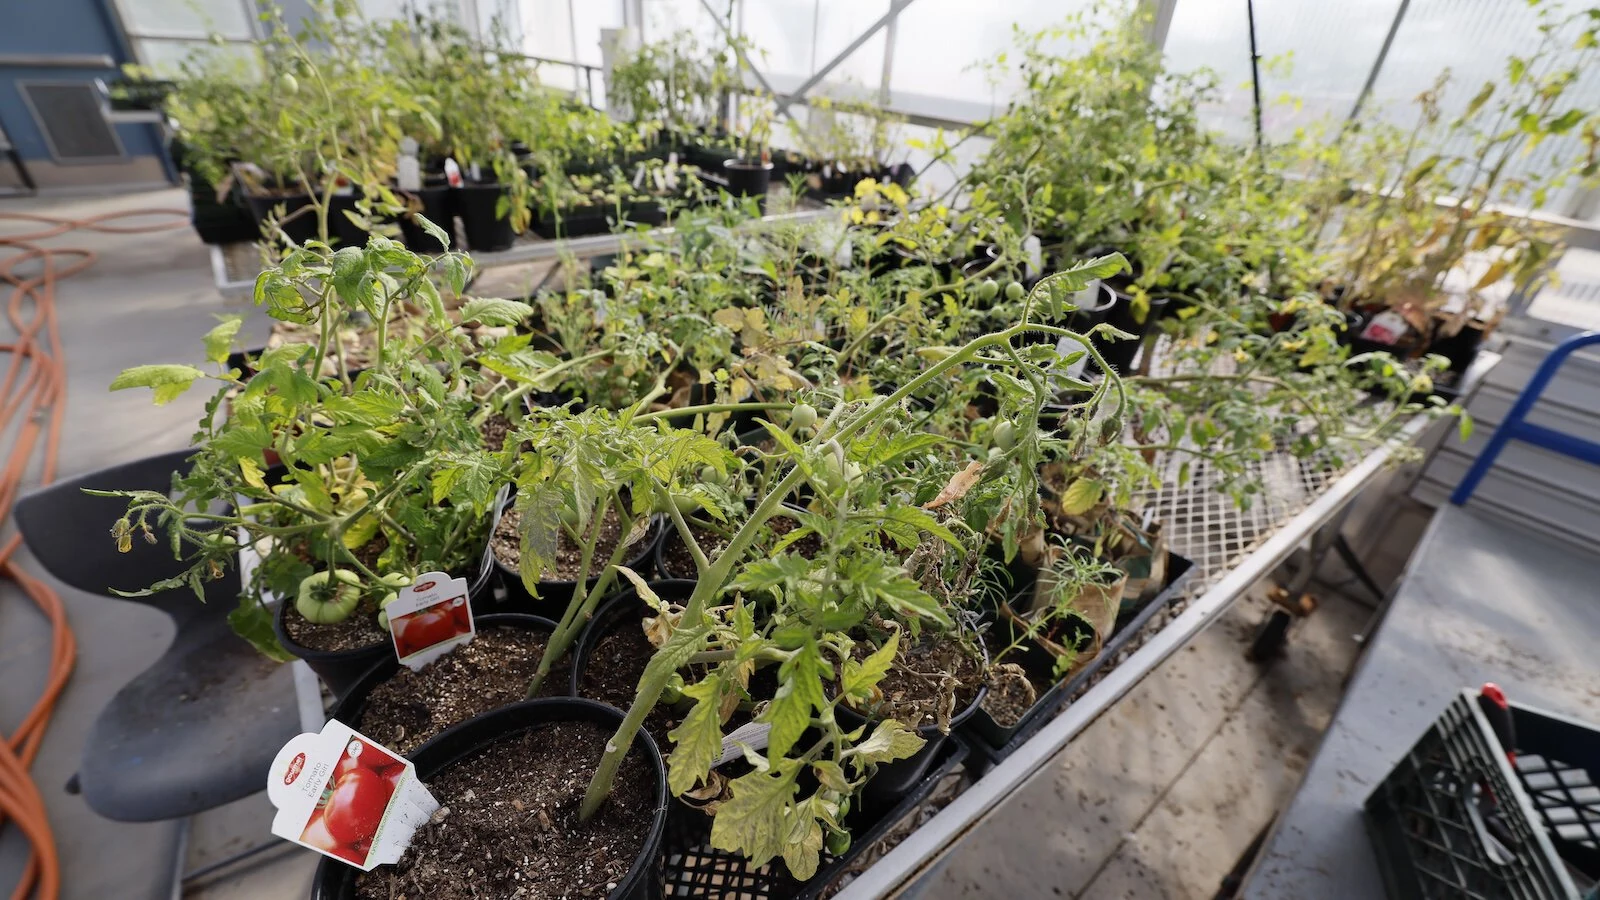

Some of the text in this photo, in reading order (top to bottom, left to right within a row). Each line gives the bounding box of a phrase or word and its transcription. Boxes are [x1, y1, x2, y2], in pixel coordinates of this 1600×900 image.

[302, 763, 322, 791] Tomato
[309, 763, 329, 798] Early Girl
